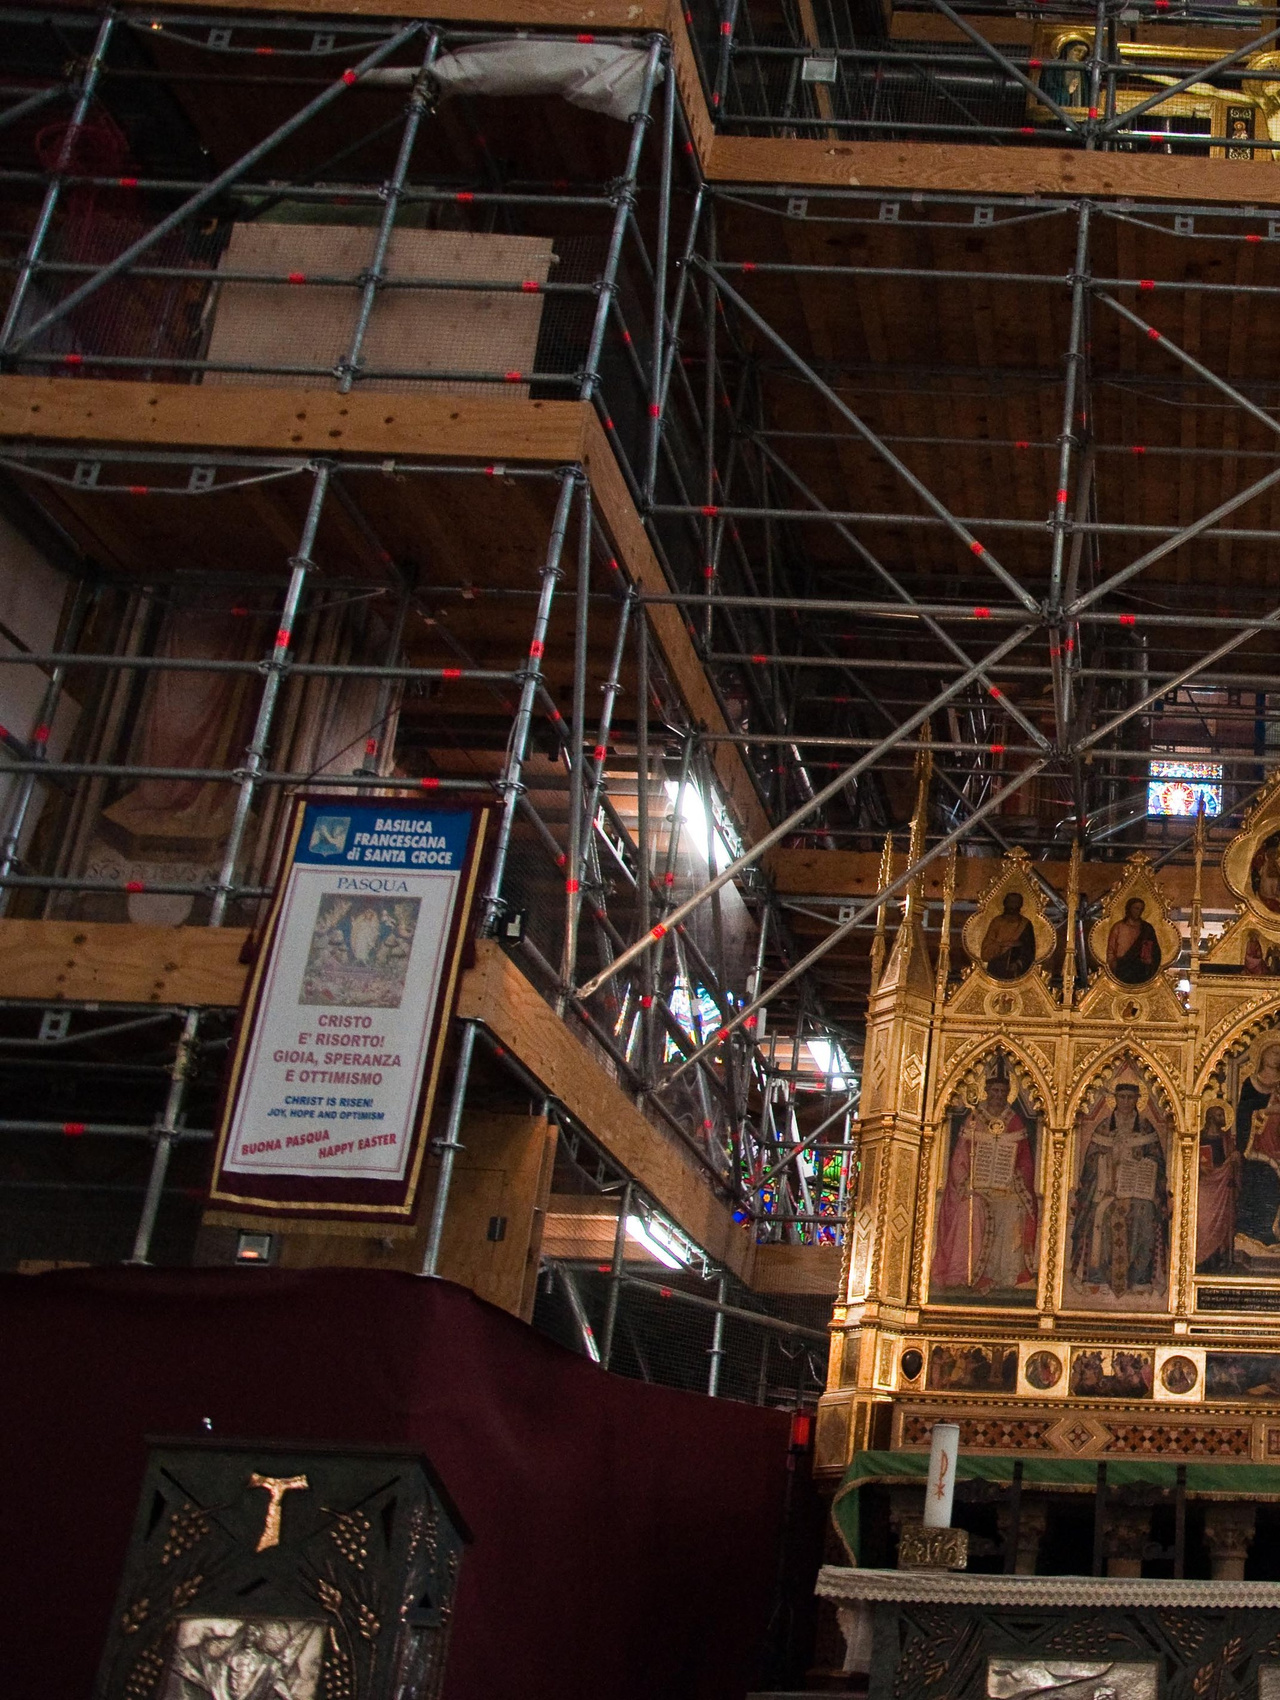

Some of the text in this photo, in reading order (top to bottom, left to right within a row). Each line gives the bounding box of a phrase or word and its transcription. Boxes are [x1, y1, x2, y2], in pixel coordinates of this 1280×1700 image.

[374, 818, 433, 834] BASILICA
[353, 832, 446, 849] FRANCESCANA
[346, 847, 453, 865] di SANTA CROCE
[337, 877, 409, 893] PASQUA
[318, 1014, 373, 1029] CRISTO
[298, 1032, 385, 1048] E' RISORTO!
[273, 1050, 402, 1067] GIOIA, SPERANZA
[285, 1069, 383, 1086] E OTTIMISMO
[284, 1095, 374, 1108] CHRIST IS RISEN!
[267, 1108, 385, 1121] JOY, HOPE AND OPTIMISM
[241, 1129, 330, 1156] BUONA PASQUA
[318, 1133, 397, 1159] HAPPY EASTER
